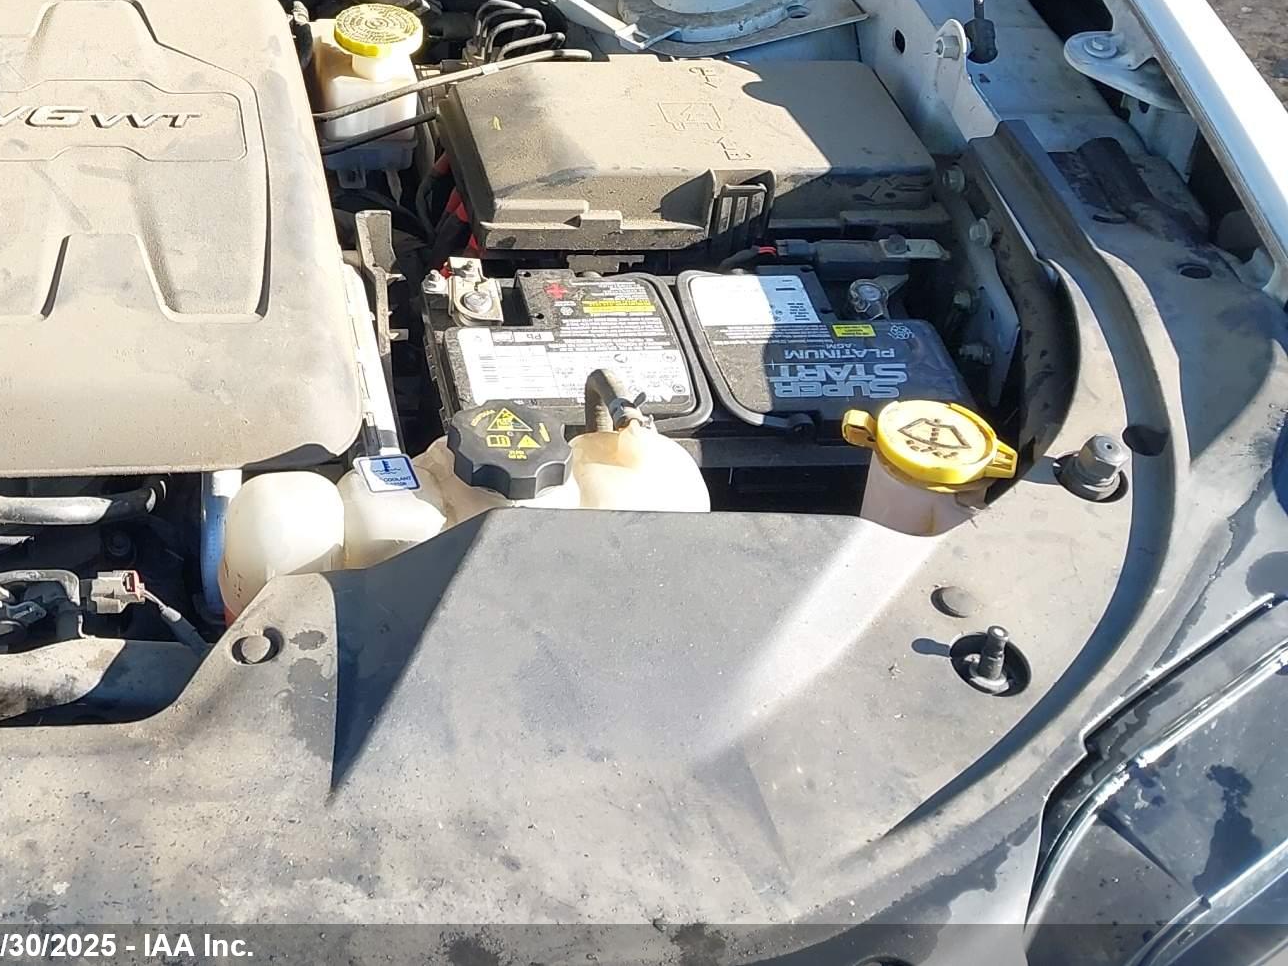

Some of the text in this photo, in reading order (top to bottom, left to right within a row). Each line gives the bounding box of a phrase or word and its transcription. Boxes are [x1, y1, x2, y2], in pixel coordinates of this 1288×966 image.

[90, 114, 201, 128] VVT
[783, 347, 895, 359] PLATINUM
[769, 362, 907, 383] START
[773, 380, 899, 398] SUPER
